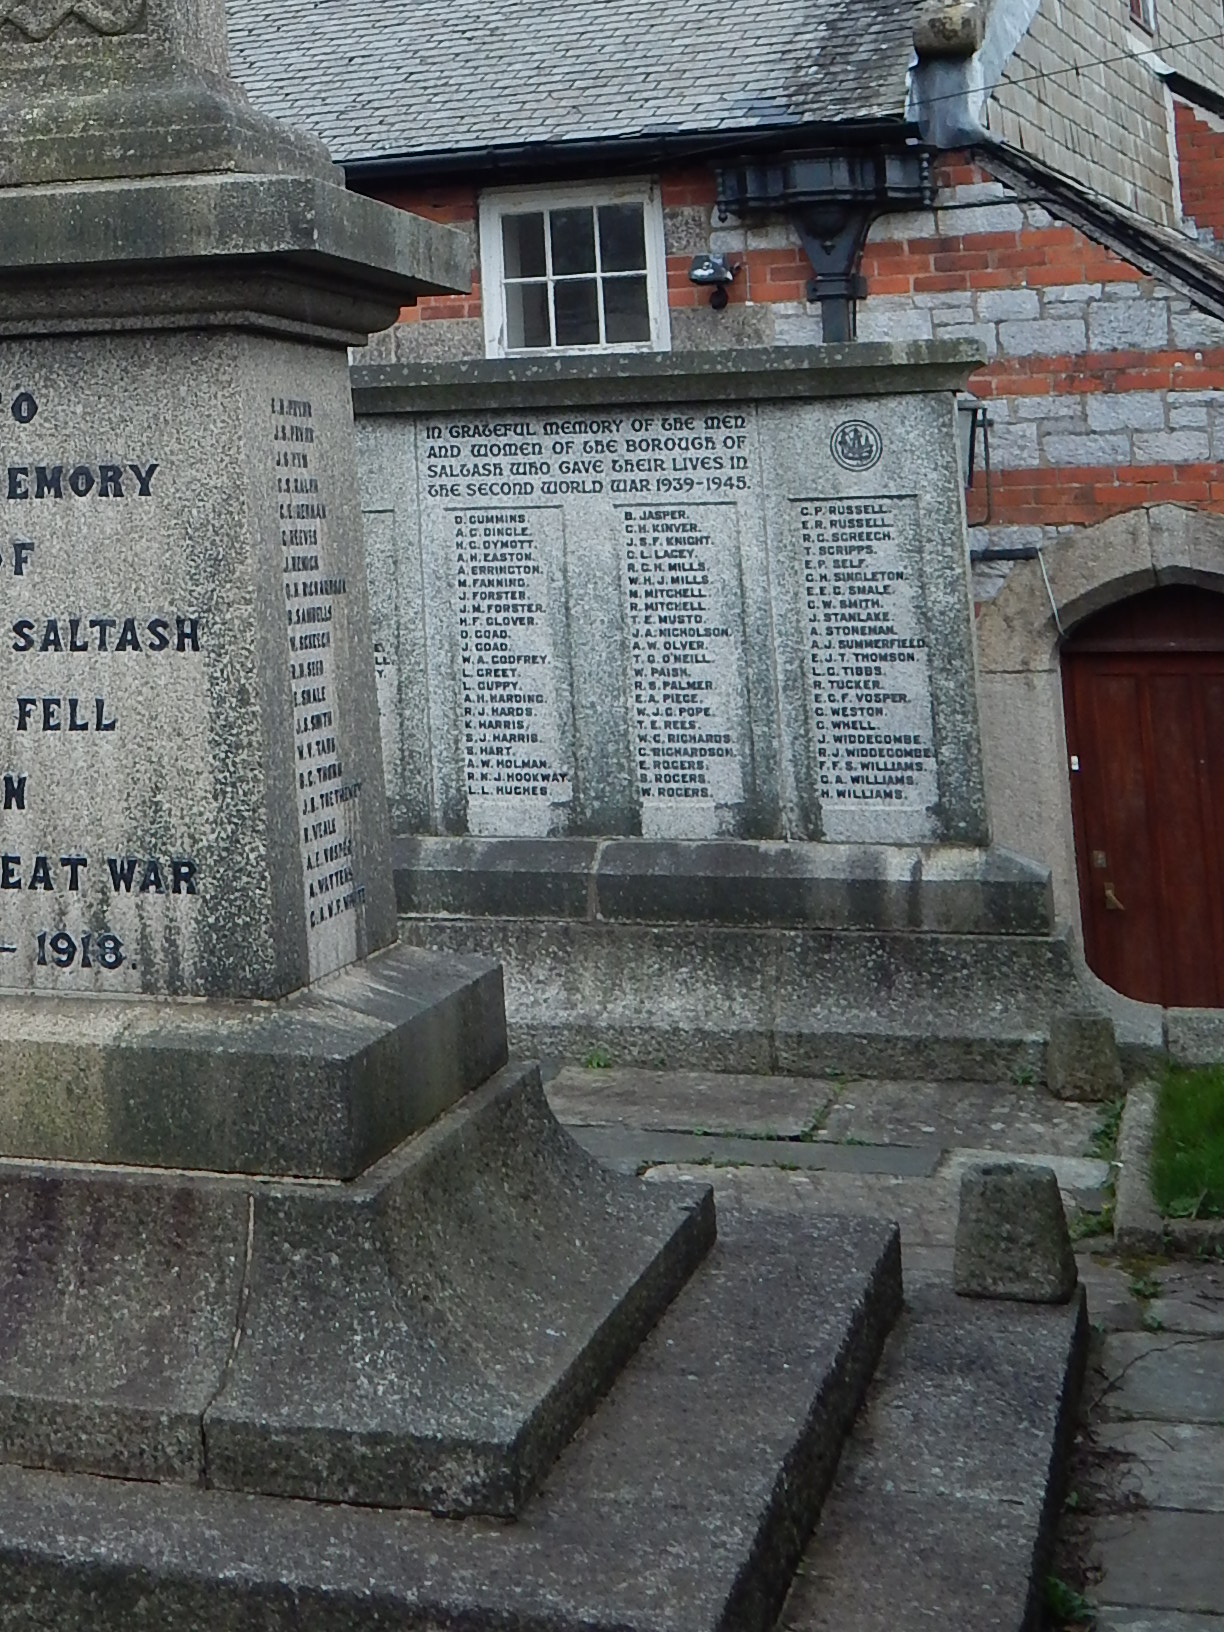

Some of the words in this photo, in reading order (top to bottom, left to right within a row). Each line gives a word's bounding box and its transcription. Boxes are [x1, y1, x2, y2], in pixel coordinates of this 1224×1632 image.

[426, 425, 442, 439] IN
[448, 423, 536, 438] GRATEFUL
[543, 420, 623, 436] MEMORY
[631, 419, 653, 433] OF
[661, 417, 695, 431] THE
[704, 416, 746, 429] MEN
[427, 445, 461, 459] AND
[470, 443, 542, 457] WOMEN
[552, 441, 575, 455] OF
[582, 438, 618, 454] THE
[626, 437, 716, 453] BOROUGH
[723, 436, 746, 449] OF
[427, 464, 503, 478] SALTASH
[510, 462, 550, 476] WHO
[559, 460, 604, 475] GAVE
[612, 458, 665, 472] THEIR
[672, 456, 723, 471] LIVES
[730, 456, 748, 470] IN
[427, 484, 461, 497] THE
[467, 482, 534, 496] SECOND
[540, 480, 603, 495] WORLD
[611, 479, 651, 493] WAR
[12, 617, 202, 653] SALTASH
[18, 698, 116, 732] FELL
[107, 858, 198, 894] WAR
